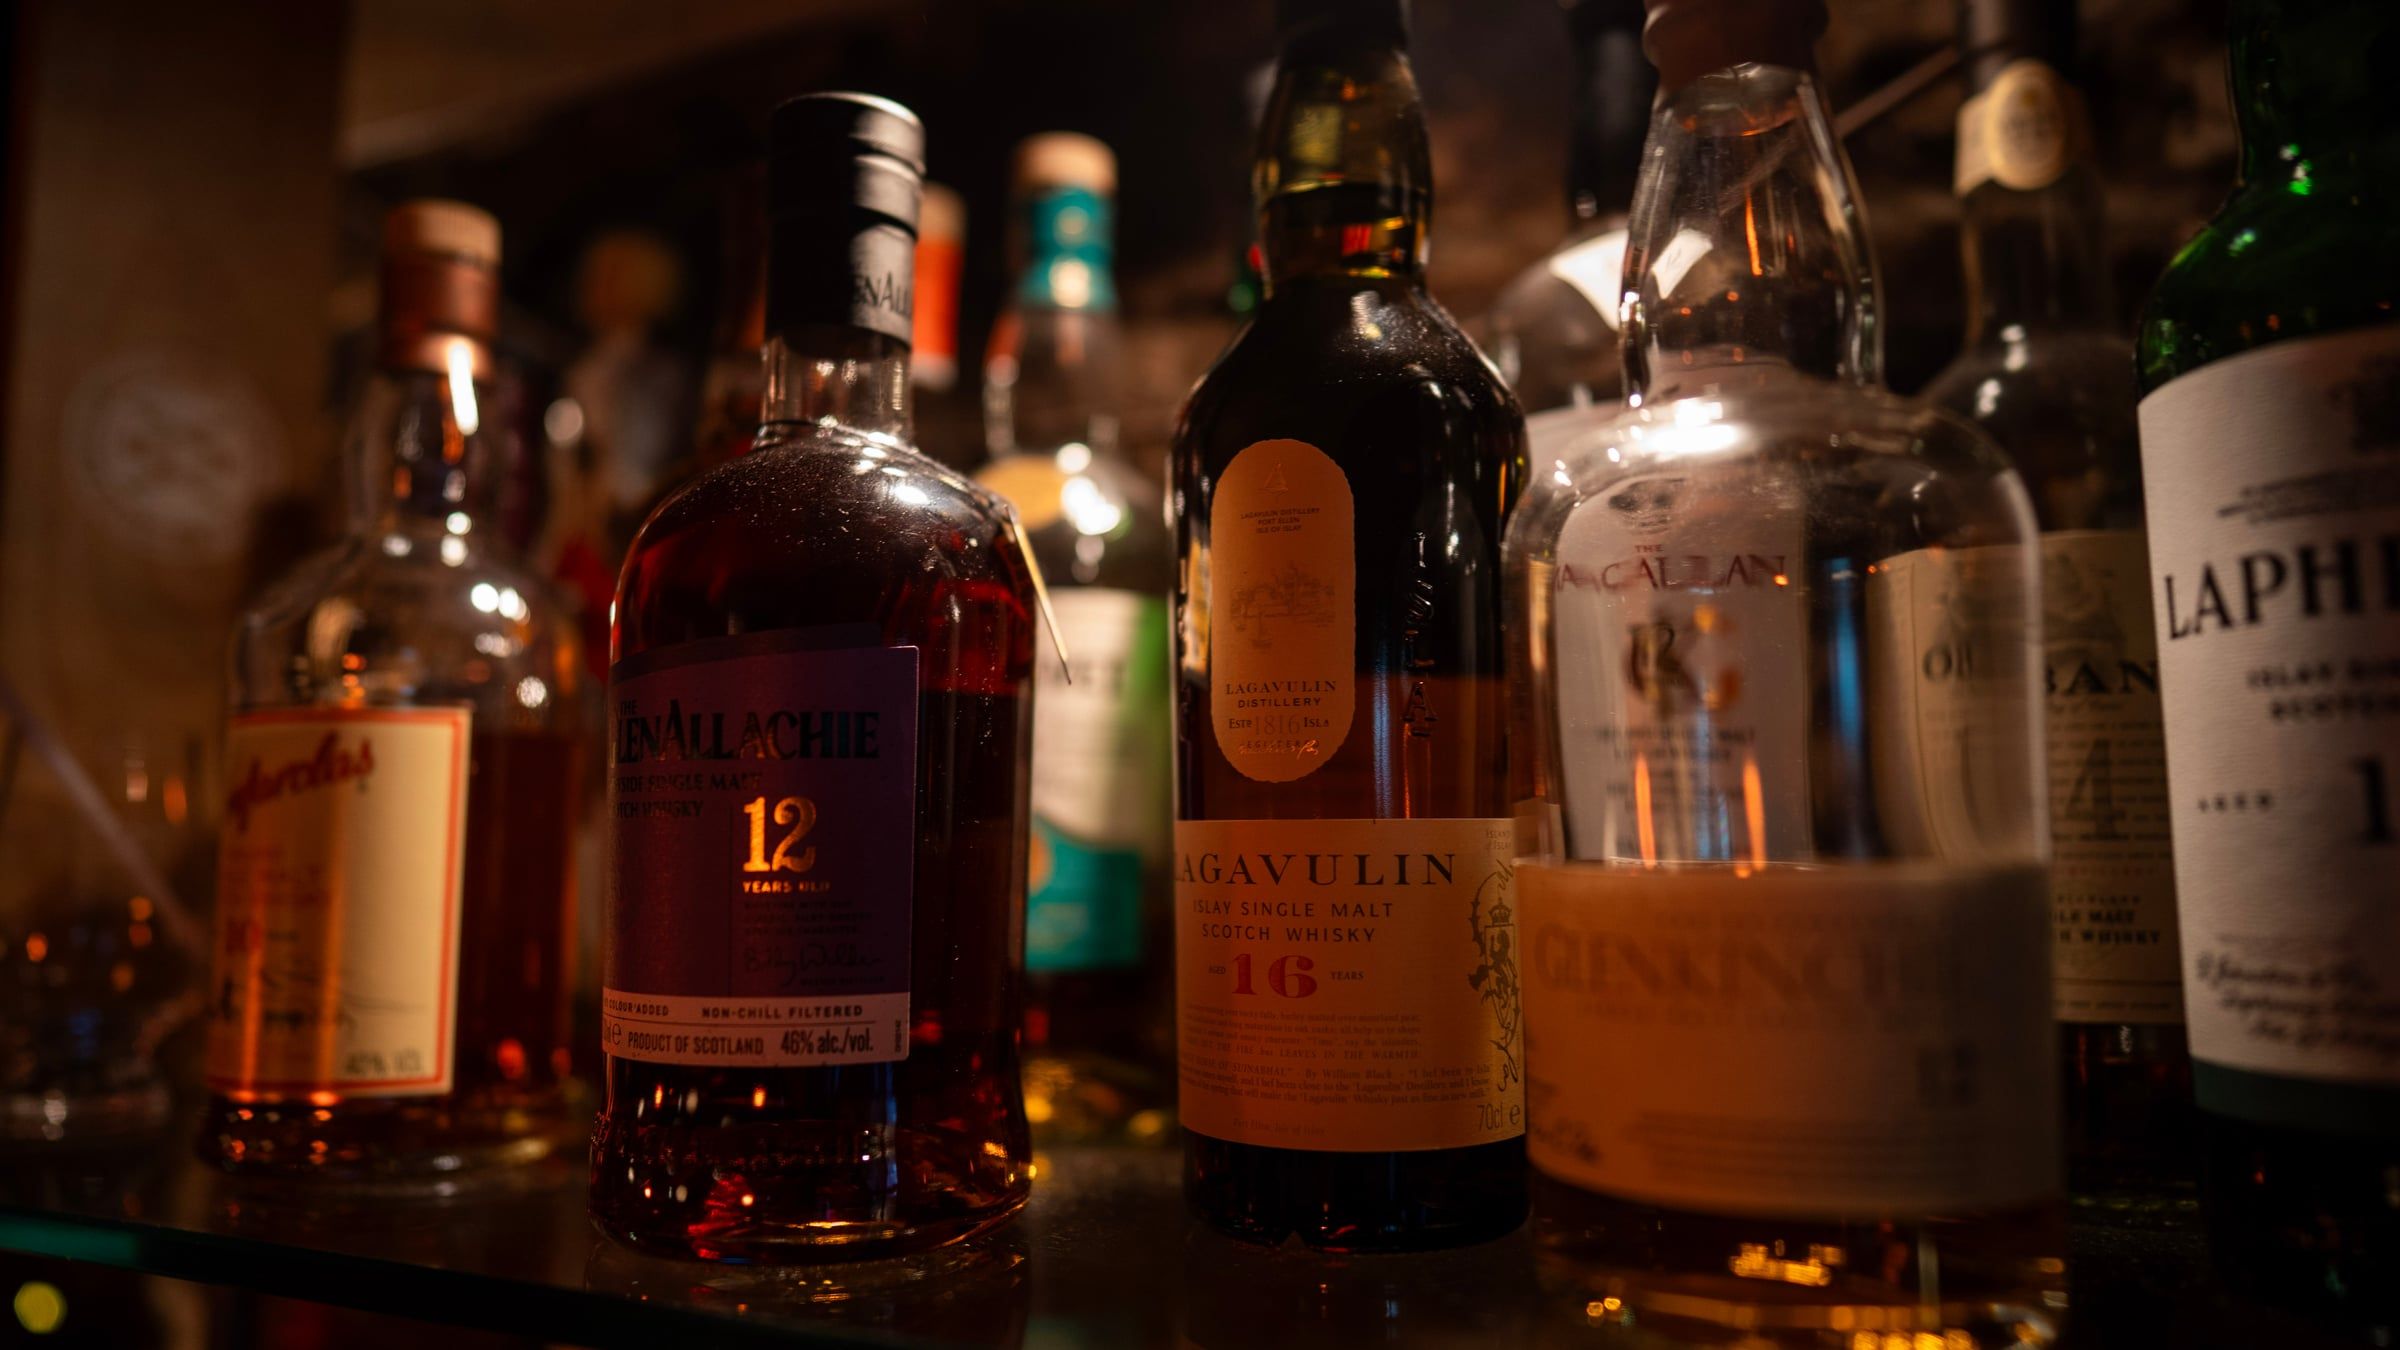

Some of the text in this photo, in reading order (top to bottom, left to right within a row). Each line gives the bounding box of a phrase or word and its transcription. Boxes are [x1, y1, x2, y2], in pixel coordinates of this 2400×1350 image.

[1225, 680, 1337, 695] LAGAVULIN
[1237, 697, 1321, 709] DISTILLERY
[616, 699, 880, 764] LENALLACHIE
[741, 795, 817, 873] 12
[1177, 852, 1456, 887] AGAVULIN
[742, 880, 832, 895] YEARS OLD
[1192, 900, 1394, 918] ISLAY SINGLE MALT
[1201, 924, 1377, 943] SCOTCH WHISKY
[1231, 953, 1319, 999] 16
[1329, 970, 1365, 982] YEARS
[635, 1004, 670, 1017] ADDED
[701, 1004, 864, 1019] NON-CHILL FILTERED
[627, 1031, 673, 1052] PRODUCT
[674, 1034, 691, 1054] OF
[693, 1035, 764, 1055] SCOTLAND
[780, 1029, 815, 1056] 46%
[816, 1026, 874, 1055] alc./vol.
[1476, 1102, 1504, 1132] 70cl
